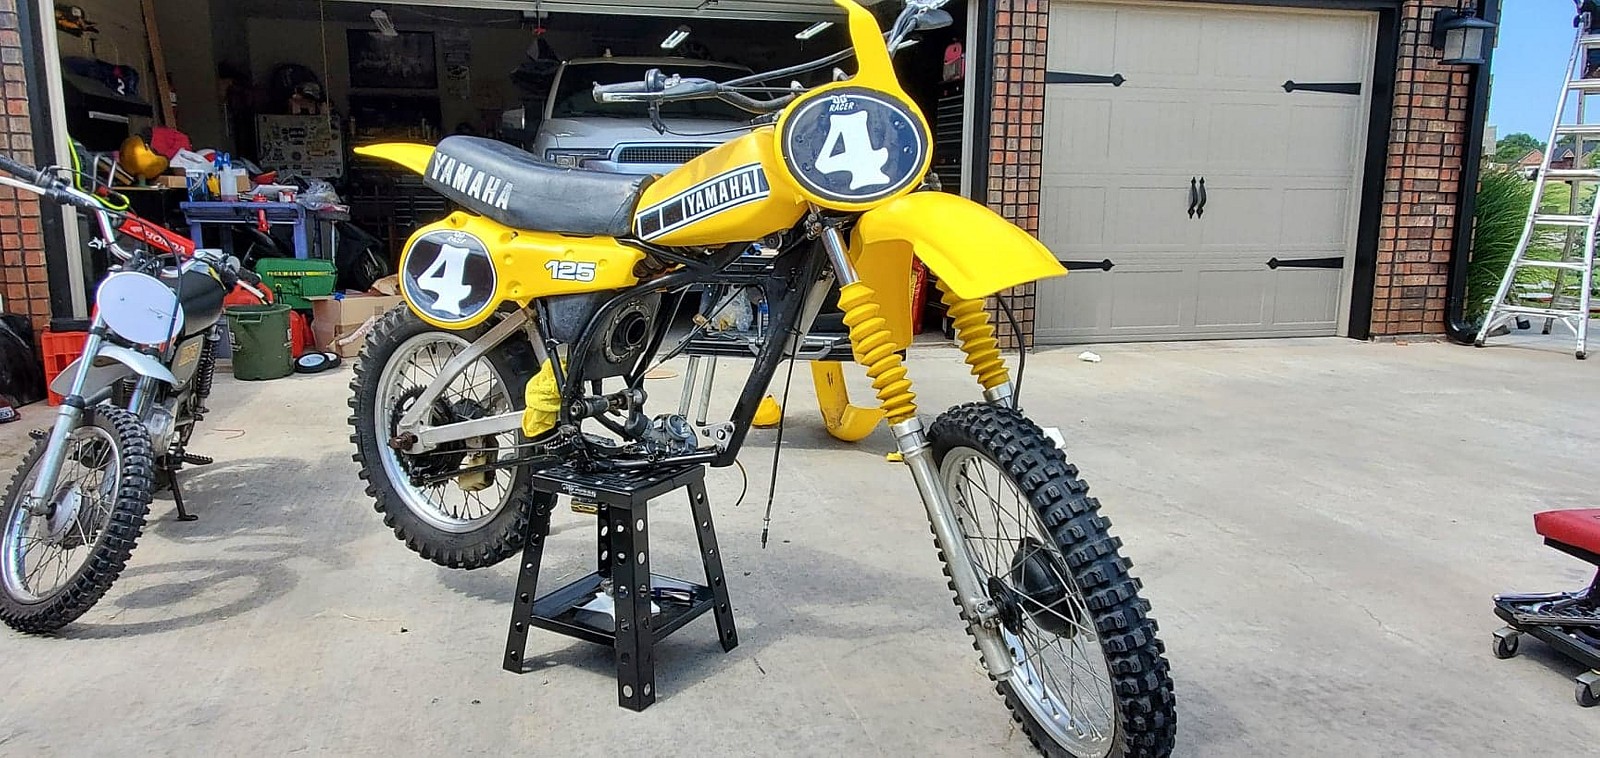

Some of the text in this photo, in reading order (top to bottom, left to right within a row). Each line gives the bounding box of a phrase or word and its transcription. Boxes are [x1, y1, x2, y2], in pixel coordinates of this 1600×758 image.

[117, 77, 126, 95] 2
[829, 102, 855, 112] RACER
[814, 110, 891, 190] 4
[432, 152, 514, 210] YAMAHA
[686, 172, 753, 216] YAMAHA
[145, 230, 186, 255] HONDA
[417, 243, 472, 315] 4
[544, 260, 597, 282] 125
